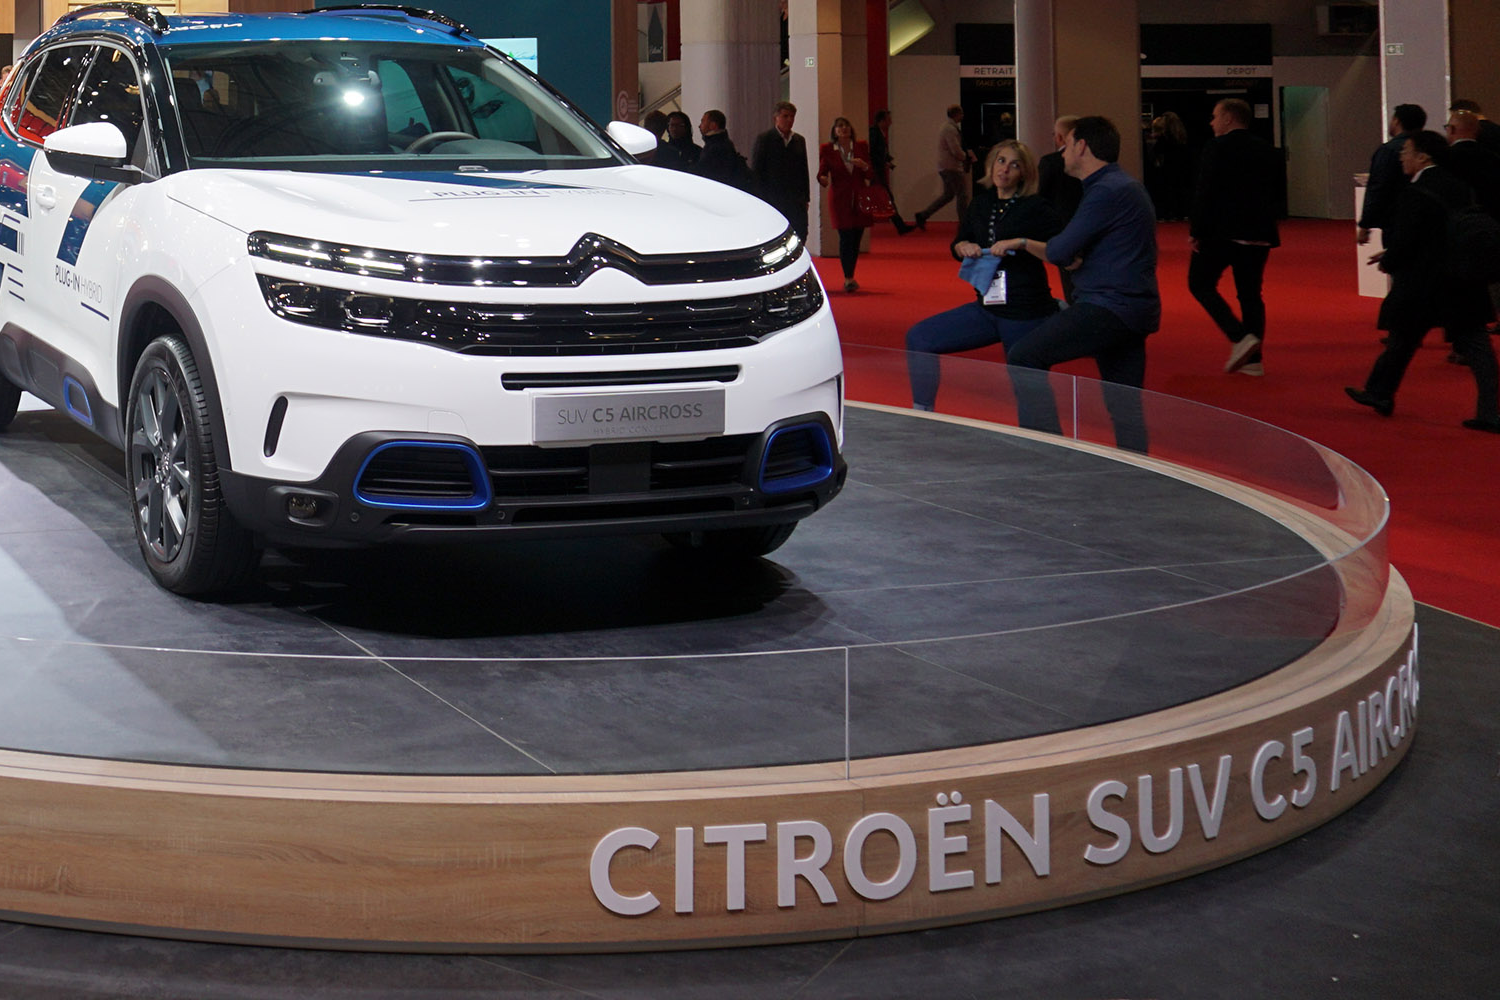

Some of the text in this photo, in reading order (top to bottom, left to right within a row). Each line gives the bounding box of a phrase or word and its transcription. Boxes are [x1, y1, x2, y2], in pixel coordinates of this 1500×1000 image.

[974, 67, 1014, 76] RETRAIT
[557, 402, 704, 425] SUV C5 AIRCROSS
[589, 790, 1050, 916] CITROËN
[1083, 753, 1232, 865] SUV
[1250, 726, 1318, 820] C5
